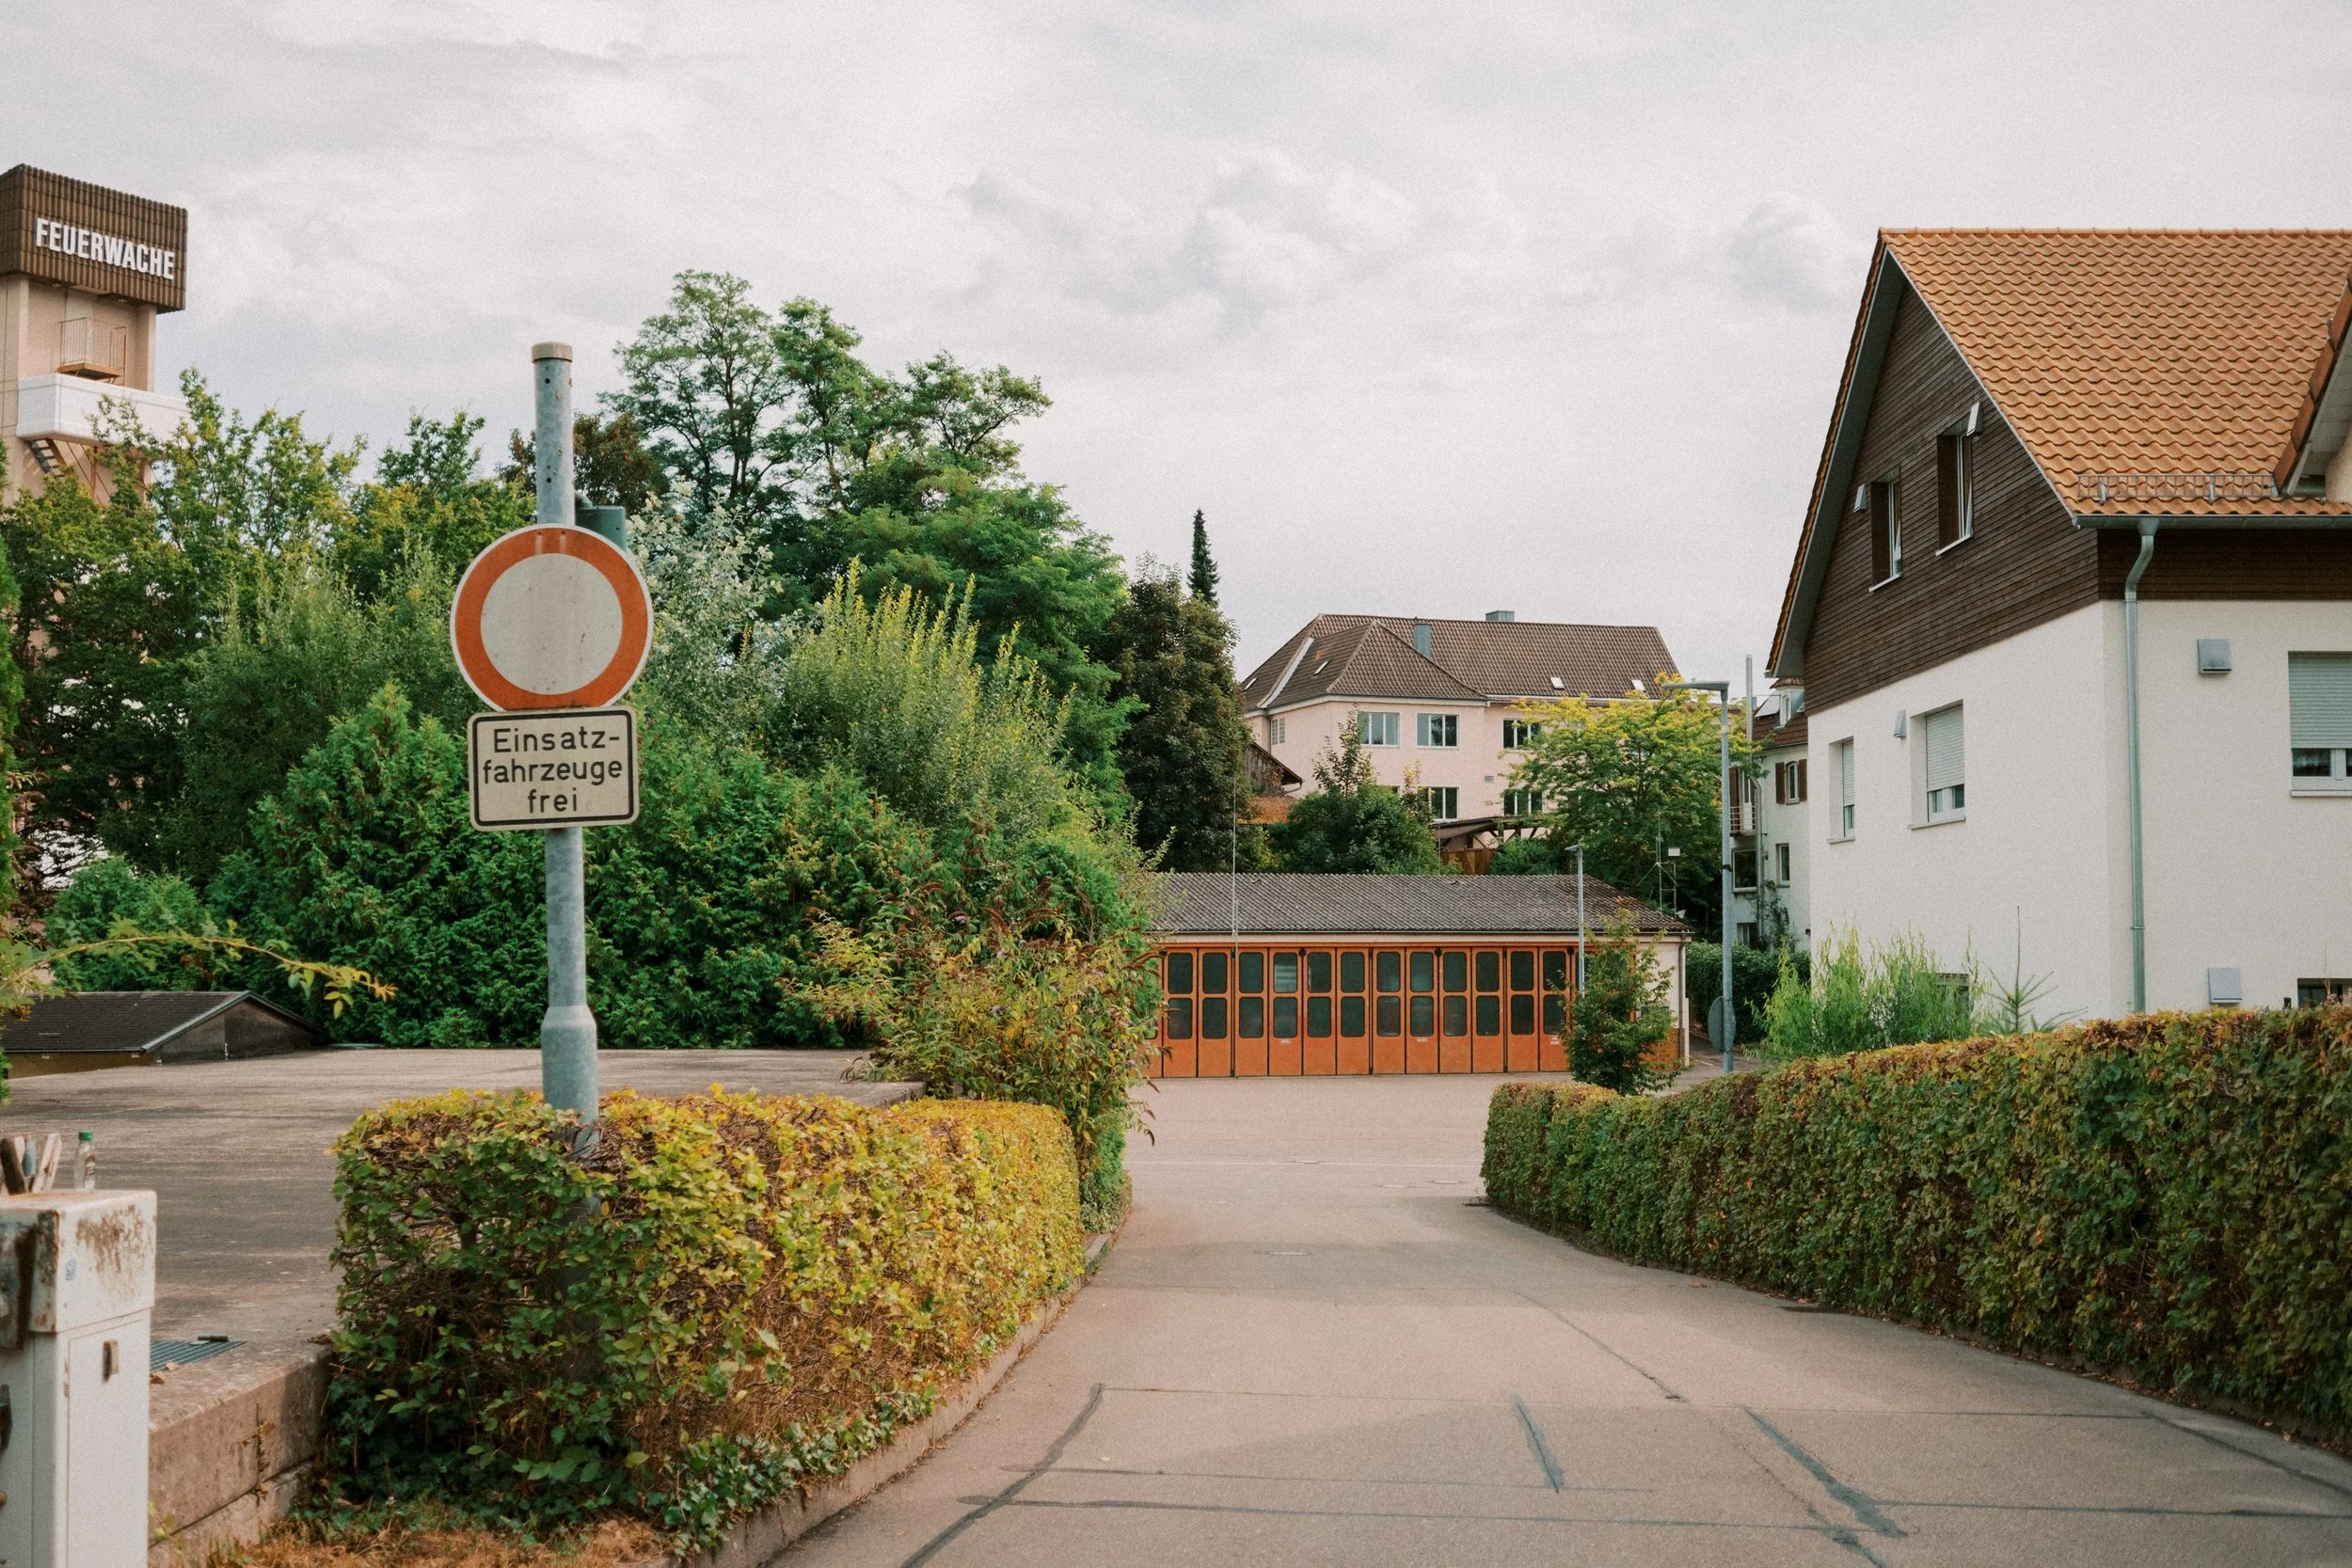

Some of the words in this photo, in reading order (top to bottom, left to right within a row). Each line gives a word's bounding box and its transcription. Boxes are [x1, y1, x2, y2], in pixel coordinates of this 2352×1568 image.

[36, 217, 175, 280] FEUERWACHE
[493, 726, 620, 752] Einsatz-
[483, 758, 623, 785] fahrzeuge
[528, 787, 578, 813] frei
